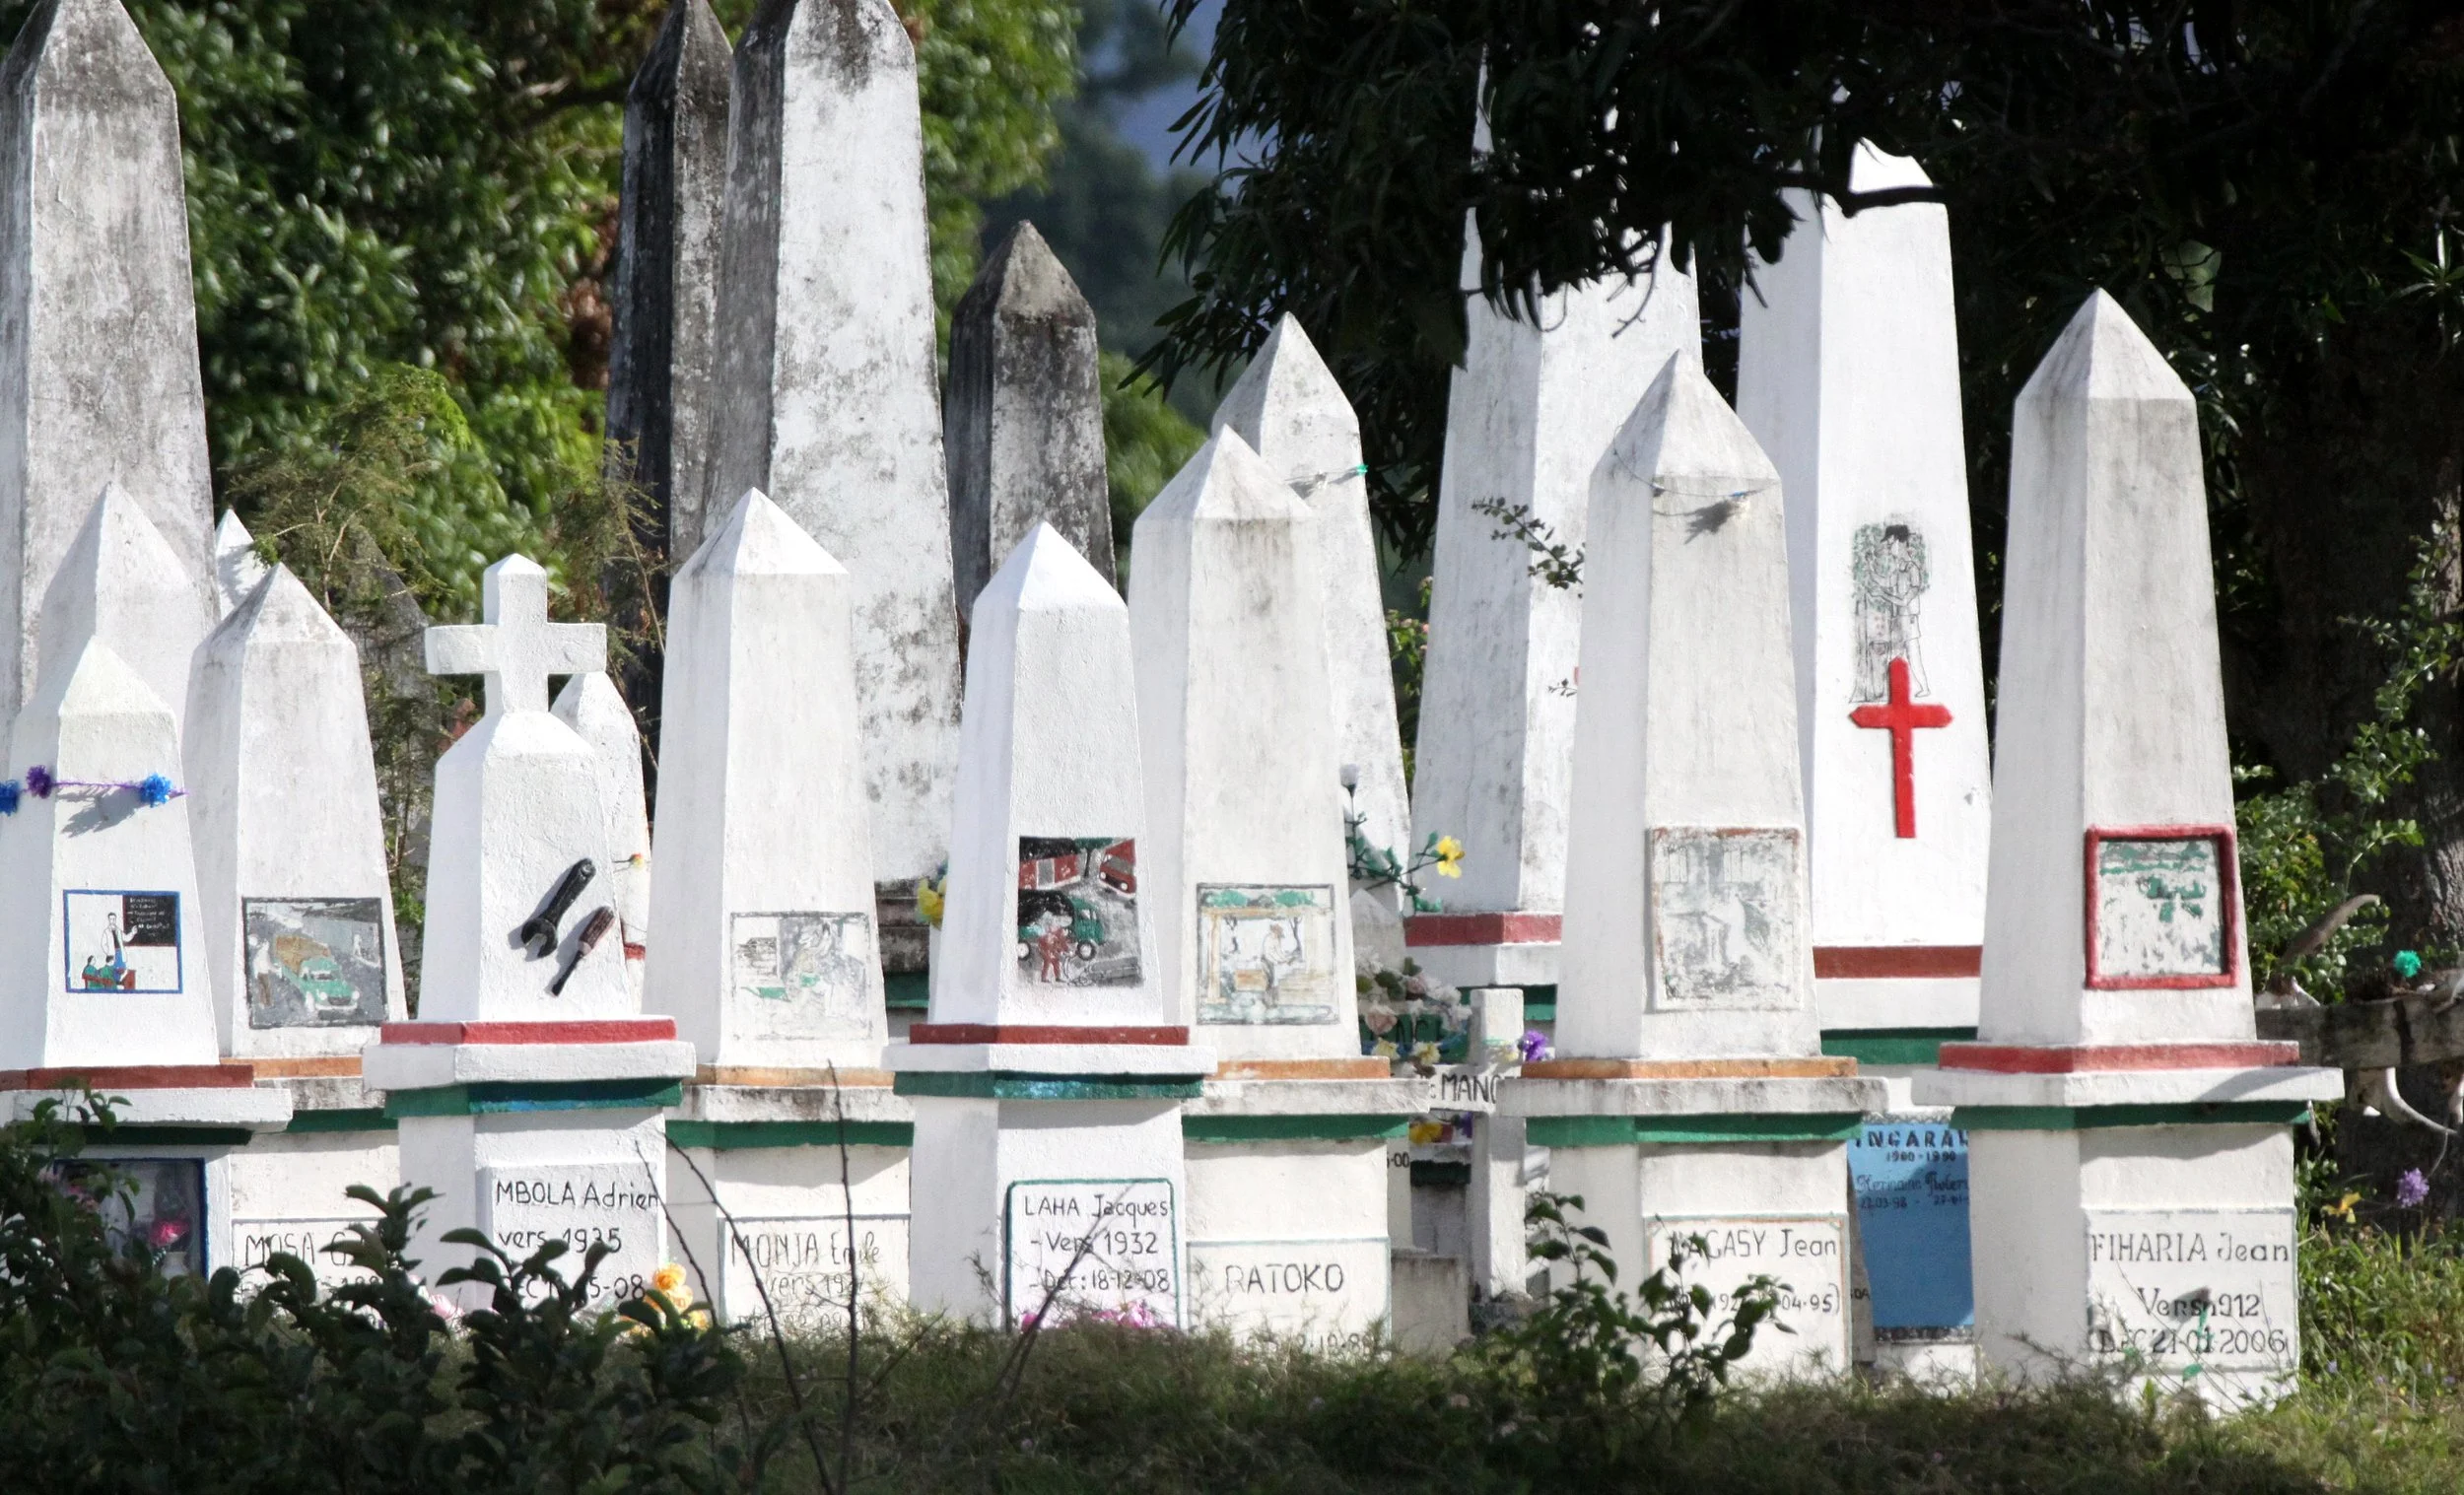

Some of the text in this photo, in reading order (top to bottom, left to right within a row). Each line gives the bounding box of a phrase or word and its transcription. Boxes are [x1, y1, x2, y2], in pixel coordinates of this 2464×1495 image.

[496, 1180, 659, 1211] MBOLA Adrien
[1024, 1193, 1169, 1229] LAHA Jacques
[498, 1230, 546, 1249] vers
[731, 1233, 820, 1267] MONJA
[1104, 1231, 1158, 1255] 1932
[1779, 1228, 1838, 1257] Jean
[2091, 1232, 2290, 1262] FIHARIA Jean
[1225, 1263, 1343, 1293] RATOKO
[2138, 1287, 2203, 1318] Vers
